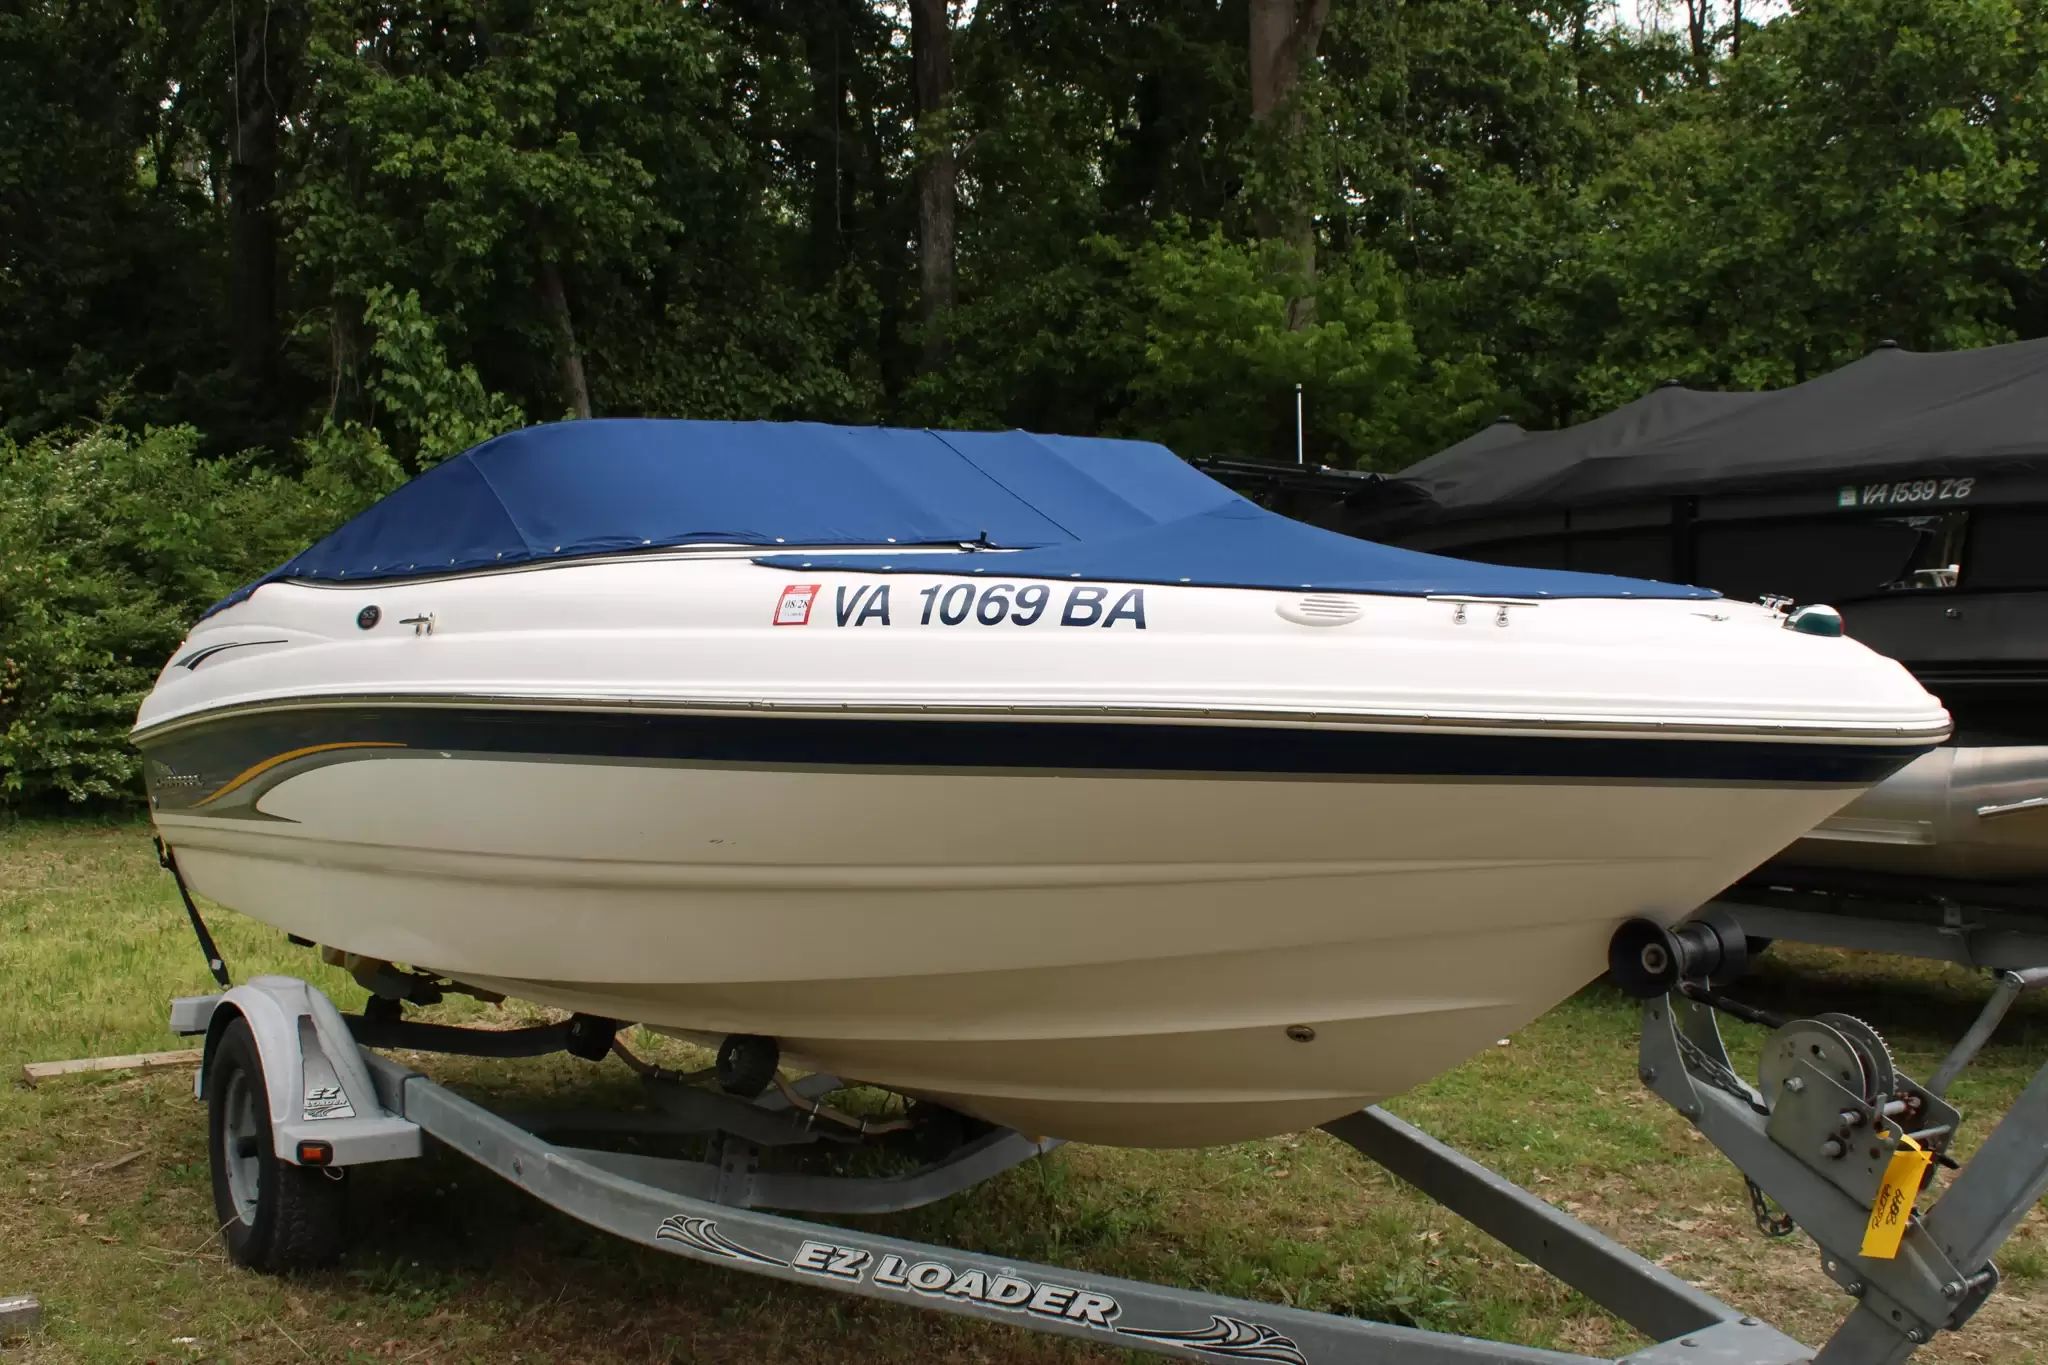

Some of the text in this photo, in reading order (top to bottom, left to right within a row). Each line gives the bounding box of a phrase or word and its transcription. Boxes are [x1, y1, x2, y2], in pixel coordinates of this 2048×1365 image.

[1862, 484, 1888, 505] VA
[1939, 477, 1976, 500] ZB
[836, 583, 1147, 629] VA 1069 BA
[306, 1086, 341, 1100] EZ
[792, 1240, 1121, 1330] EZ LOADER
